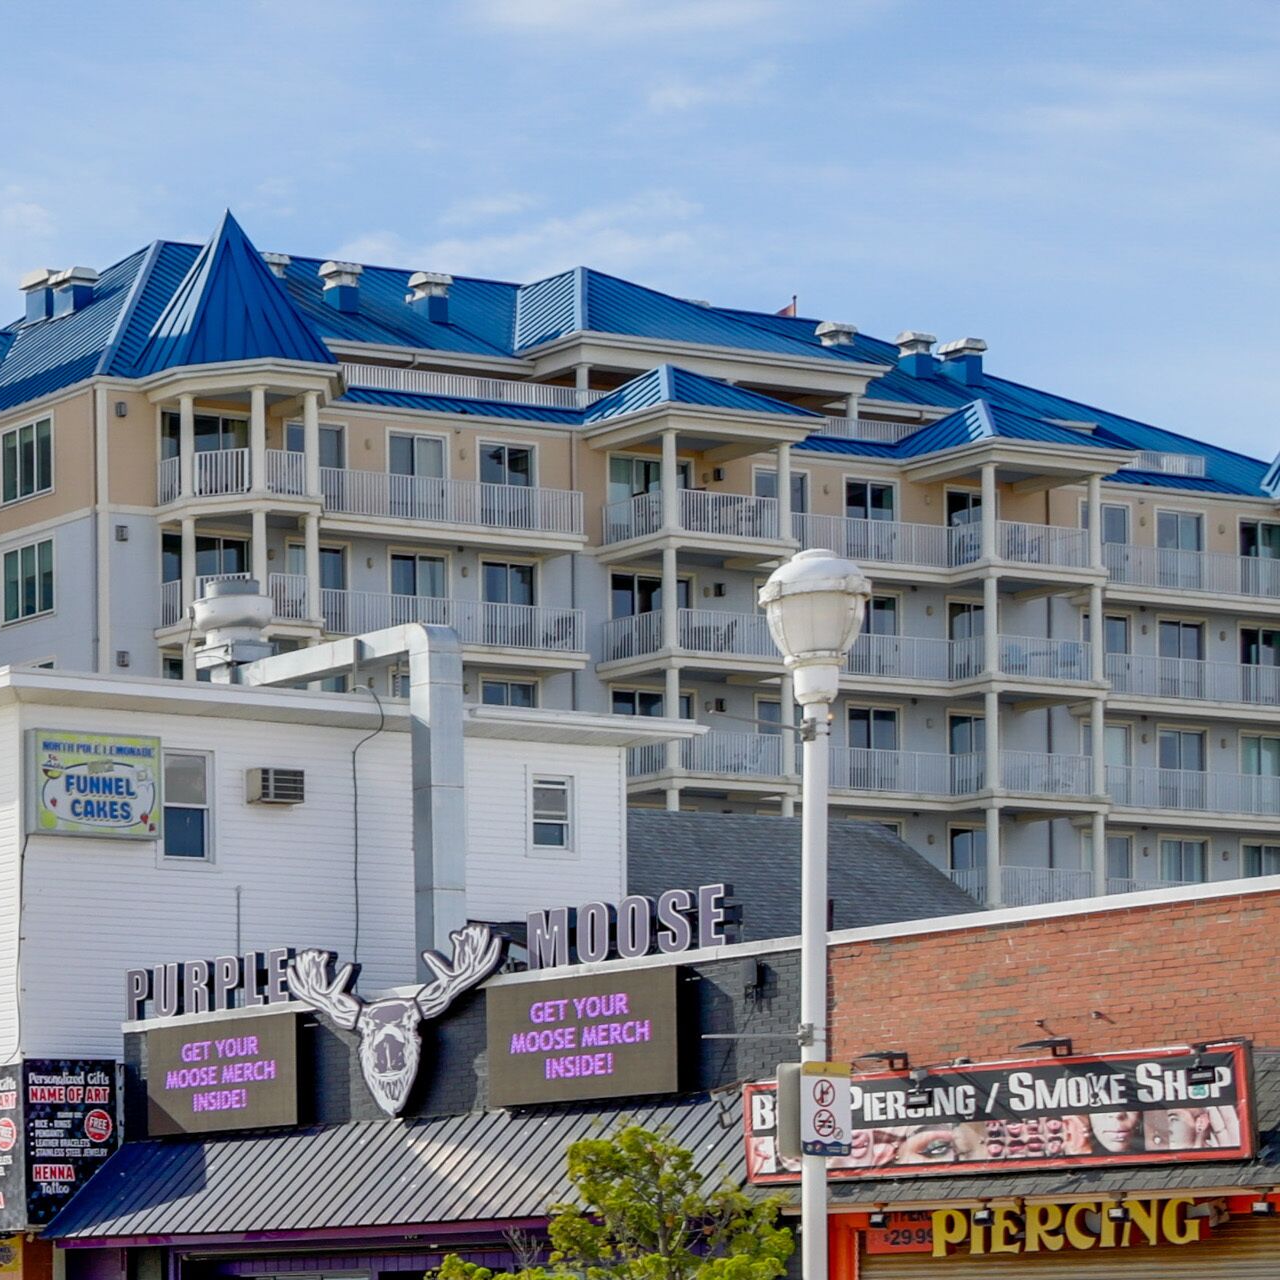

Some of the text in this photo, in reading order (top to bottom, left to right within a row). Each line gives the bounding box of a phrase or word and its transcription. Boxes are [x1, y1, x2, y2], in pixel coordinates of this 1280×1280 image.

[65, 775, 136, 797] FUNNEL
[71, 799, 132, 820] CAKES
[126, 883, 727, 1021] PURPLE MOOSE
[530, 992, 629, 1023] GET YOUR
[181, 1036, 258, 1063] GET YOUR
[510, 1020, 651, 1054] MOOSE MERCH
[28, 1071, 109, 1085] Personalized Gifts
[165, 1060, 276, 1090] MOOSE MERCH
[545, 1052, 614, 1080] INSIDE!
[29, 1086, 109, 1103] NAME OF ART
[193, 1089, 248, 1112] INSIDE!
[1008, 1071, 1128, 1111] SMOKE
[89, 1117, 108, 1129] FREE
[33, 1164, 75, 1181] HENNA
[40, 1182, 70, 1195] Tattoo
[932, 1198, 1201, 1258] PIERCING
